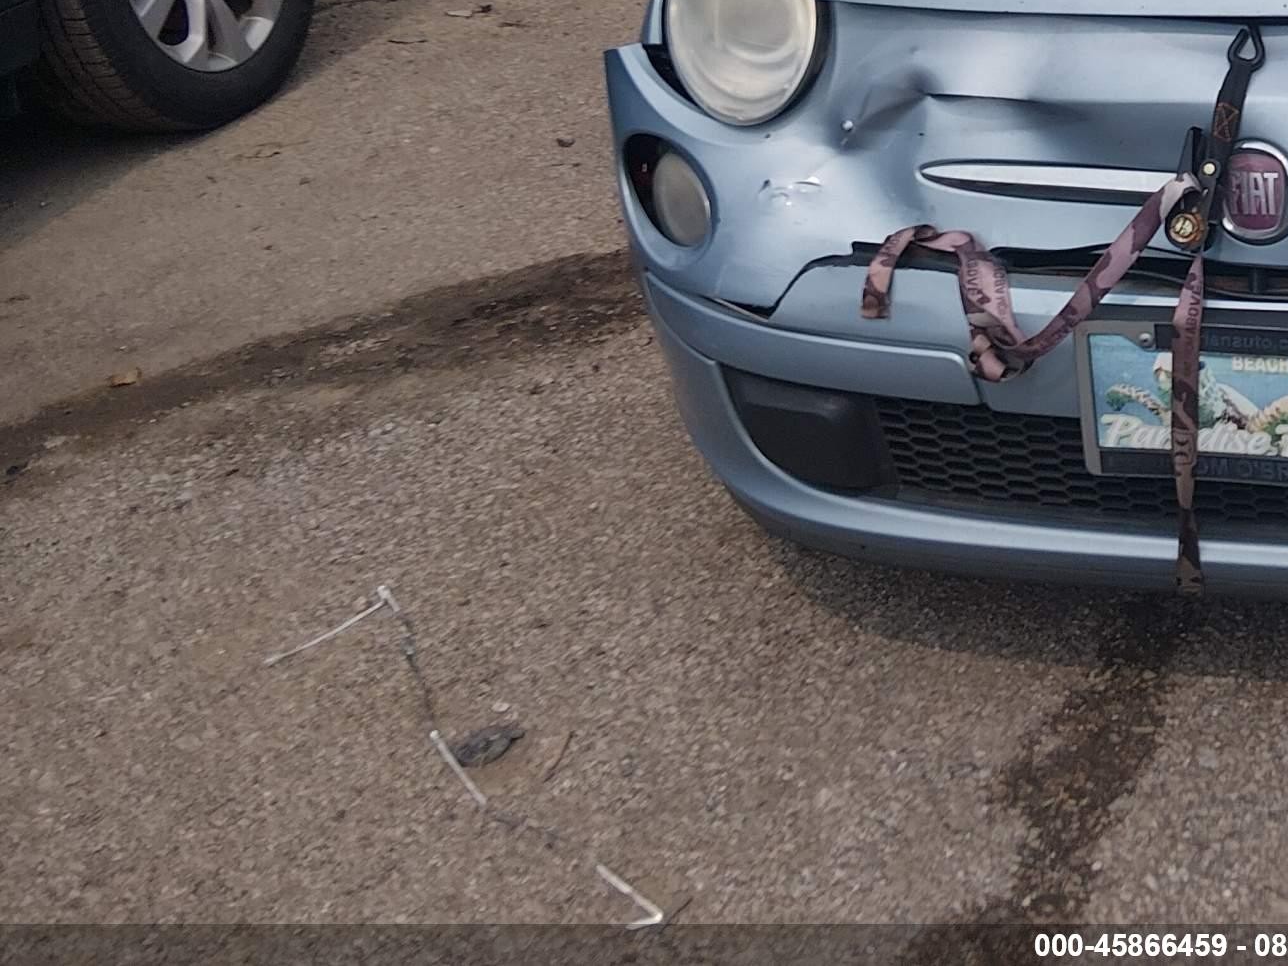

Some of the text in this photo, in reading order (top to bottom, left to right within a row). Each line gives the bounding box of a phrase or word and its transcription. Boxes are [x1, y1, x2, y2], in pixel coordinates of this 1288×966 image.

[1230, 170, 1279, 216] FIAT
[1184, 284, 1201, 334] ABOVE
[1101, 413, 1272, 457] Pardise
